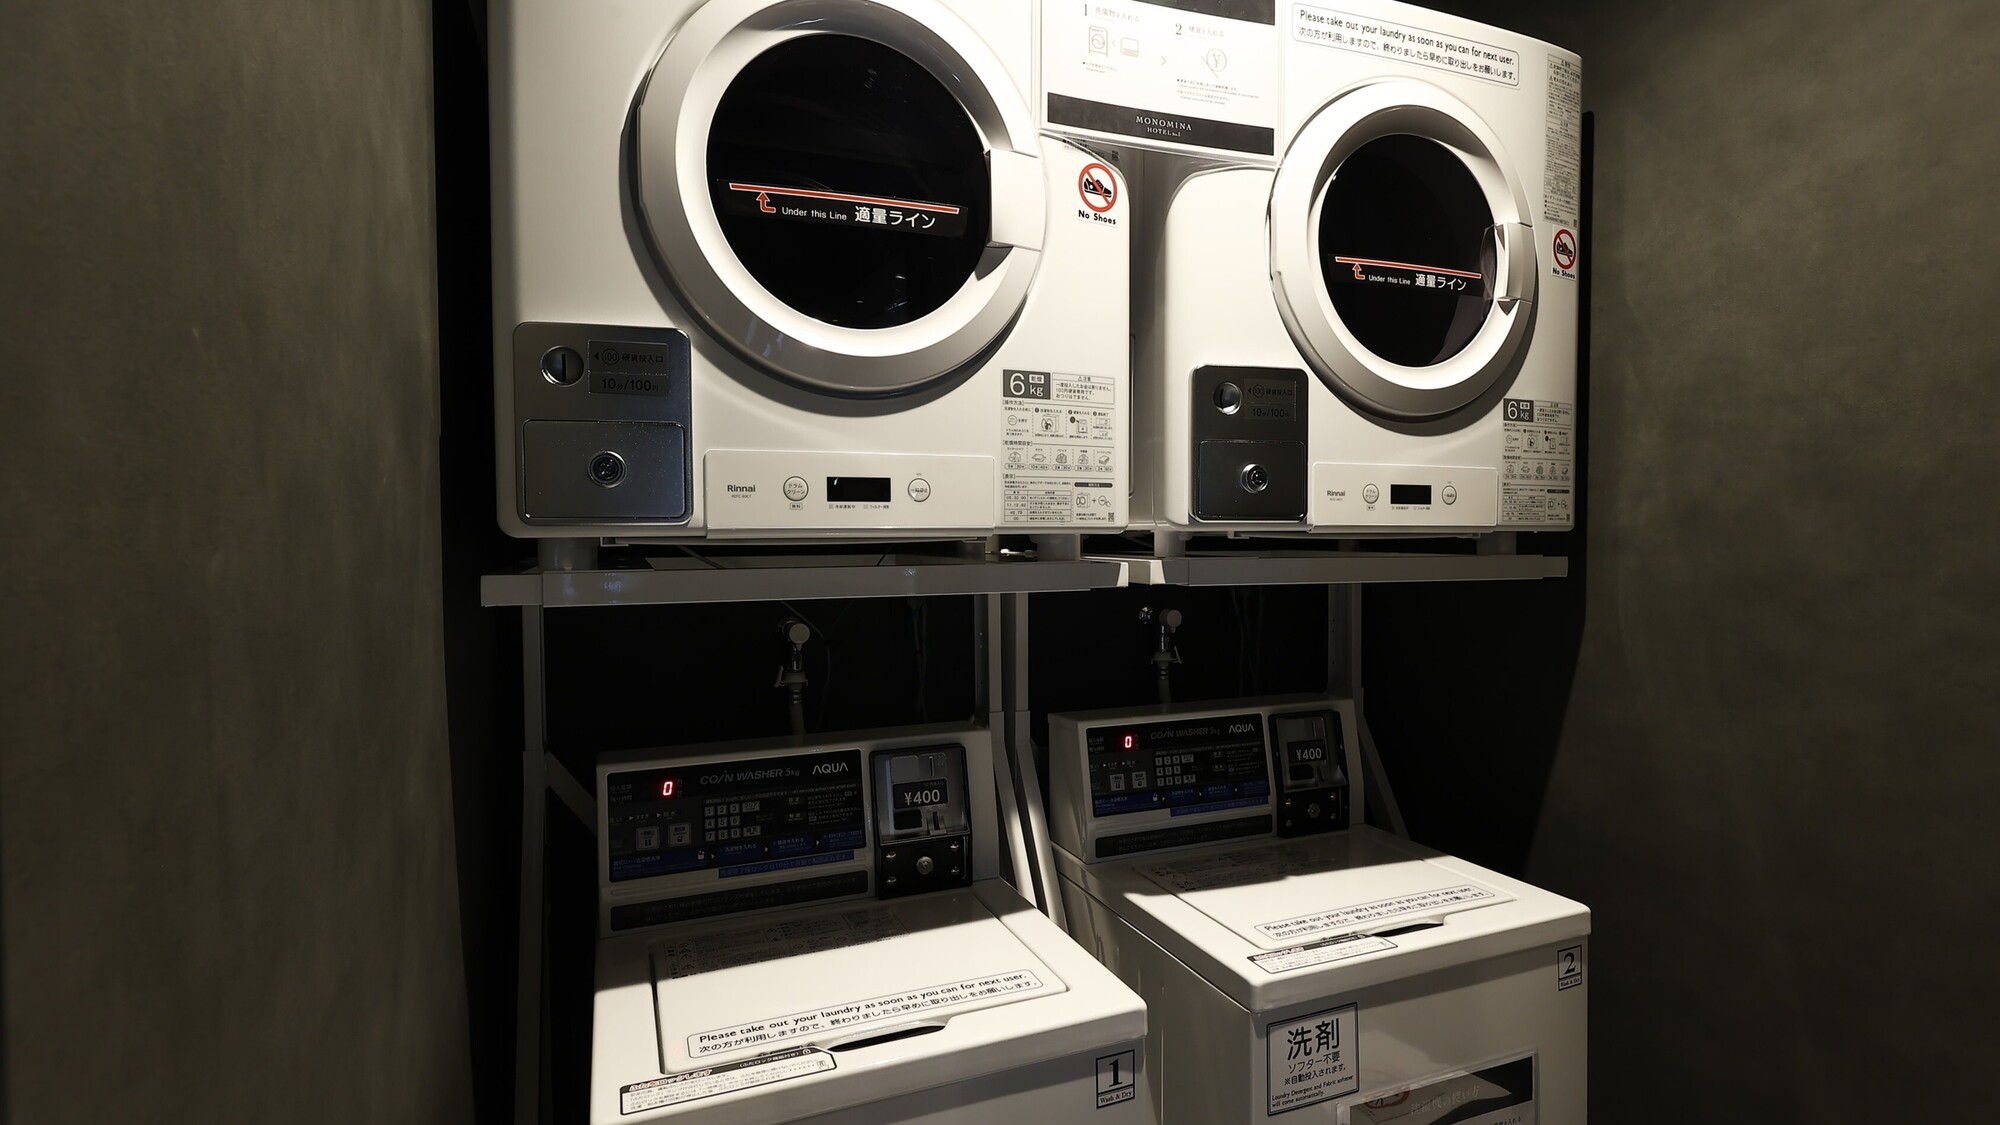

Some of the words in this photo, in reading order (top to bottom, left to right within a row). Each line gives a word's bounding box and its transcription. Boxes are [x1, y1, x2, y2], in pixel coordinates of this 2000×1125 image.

[1084, 3, 1088, 16] 1
[1175, 23, 1182, 35] 2
[1300, 9, 1325, 24] Please
[1326, 16, 1343, 28] take
[1345, 21, 1359, 31] out
[1361, 24, 1378, 35] your
[1380, 26, 1406, 43] laundry
[1408, 33, 1415, 43] as
[1417, 36, 1434, 47] soon
[1436, 40, 1443, 49] as
[1444, 42, 1457, 53] you
[1458, 44, 1470, 55] can
[1472, 46, 1482, 57] for
[1483, 51, 1498, 62] next
[1499, 55, 1514, 66] user.
[1136, 115, 1192, 131] MONOMINA
[1147, 127, 1171, 136] HOTEL
[781, 206, 808, 218] Under
[811, 209, 827, 219] this
[829, 210, 848, 222] Line
[855, 205, 936, 229] 適量ライン
[1078, 210, 1090, 219] No
[1094, 213, 1116, 225] Shoes
[1368, 274, 1386, 283] Under
[1387, 276, 1398, 284] this
[1399, 277, 1410, 286] Line
[1552, 267, 1560, 275] No
[1561, 270, 1576, 279] Shoes
[1415, 273, 1467, 291] 適量ライン
[621, 353, 664, 363] 硬貨投入口
[1010, 373, 1025, 396] 6
[1030, 385, 1043, 397] kg
[1508, 401, 1518, 419] 6
[1520, 410, 1530, 420] kg
[727, 484, 756, 492] Rinnai
[1124, 736, 1132, 748] 0
[1176, 727, 1208, 737] WASHER
[1228, 724, 1255, 734] AQUA
[1296, 748, 1322, 760] ¥400
[662, 781, 674, 796] 0
[736, 768, 783, 782] WASHER
[785, 767, 800, 778] 5kg
[812, 762, 849, 775] AQUA
[904, 788, 940, 806] ¥400
[1264, 923, 1290, 931] Please
[1564, 952, 1576, 974] 2
[699, 1030, 737, 1043] Please
[740, 1024, 765, 1035] take
[769, 1020, 790, 1028] out
[793, 1014, 818, 1026] your
[820, 1005, 861, 1018] laundry
[878, 996, 904, 1007] soon
[920, 990, 939, 1000] you
[940, 986, 958, 994] can
[960, 983, 976, 991] for
[978, 978, 1002, 987] next
[1002, 974, 1027, 982] user.
[699, 981, 1037, 1054] 次の方が利用しますので、終わりましたら早めに取り出しをお願いします。
[1286, 1018, 1340, 1060] 洗剤
[1288, 1050, 1340, 1074] ソフター不要
[1108, 1058, 1122, 1088] 1
[1284, 1063, 1346, 1086] ※自動投入されます。
[1323, 1080, 1336, 1088] Fabric
[1100, 1096, 1114, 1104] Wash
[1282, 1098, 1294, 1106] come
